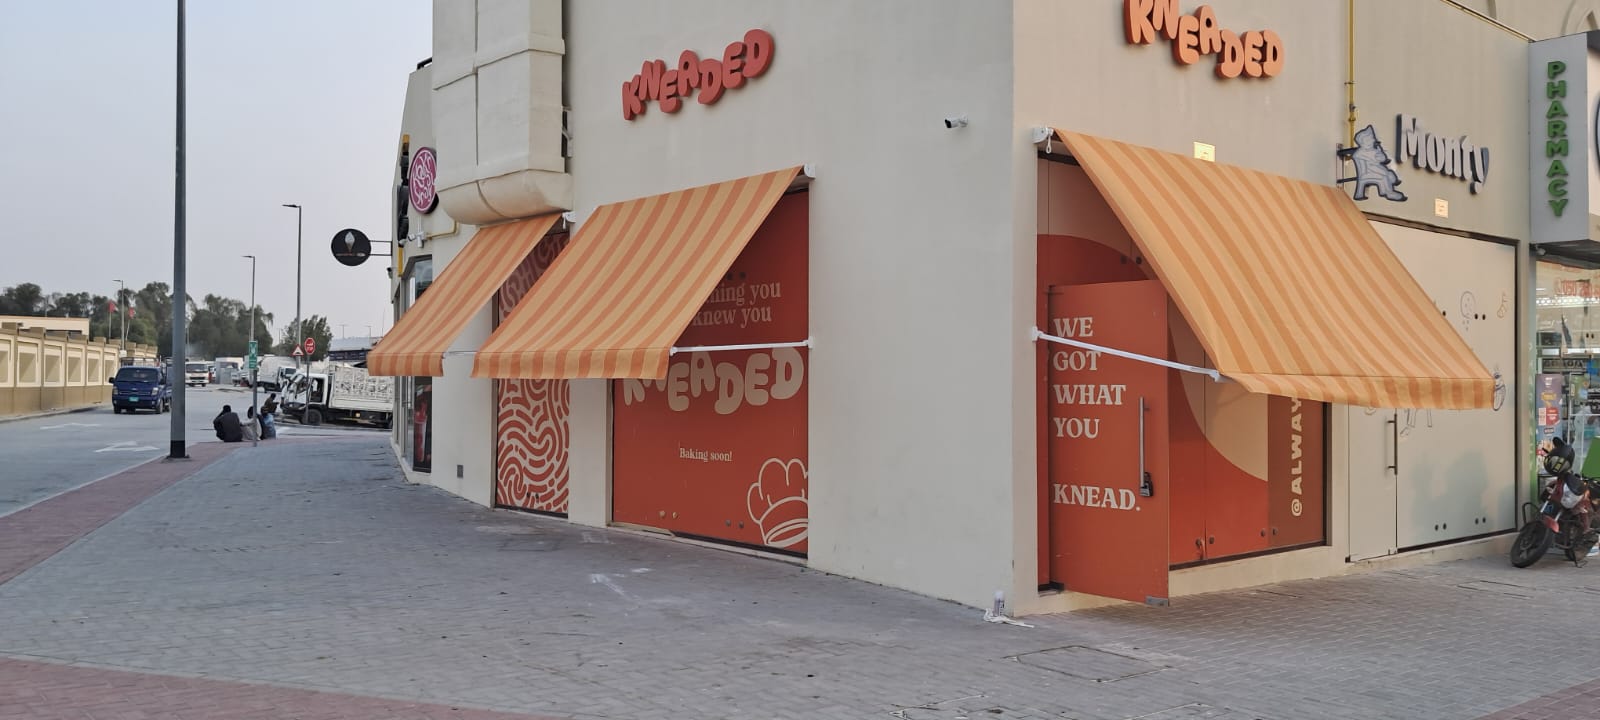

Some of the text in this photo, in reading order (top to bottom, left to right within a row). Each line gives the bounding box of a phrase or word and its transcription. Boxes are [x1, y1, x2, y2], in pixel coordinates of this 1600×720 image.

[1123, 0, 1284, 79] KNEADED
[622, 29, 775, 120] KNEADED
[1546, 60, 1569, 217] PHARMACY
[1396, 114, 1490, 195] Monty
[750, 282, 781, 305] you
[741, 306, 772, 329] you
[1053, 317, 1093, 337] WE
[1053, 350, 1101, 371] GOT
[1053, 384, 1126, 405] WHAT
[1053, 417, 1100, 439] YOU
[680, 447, 732, 462] Baking soon!
[1053, 483, 1140, 511] KNEAD.
